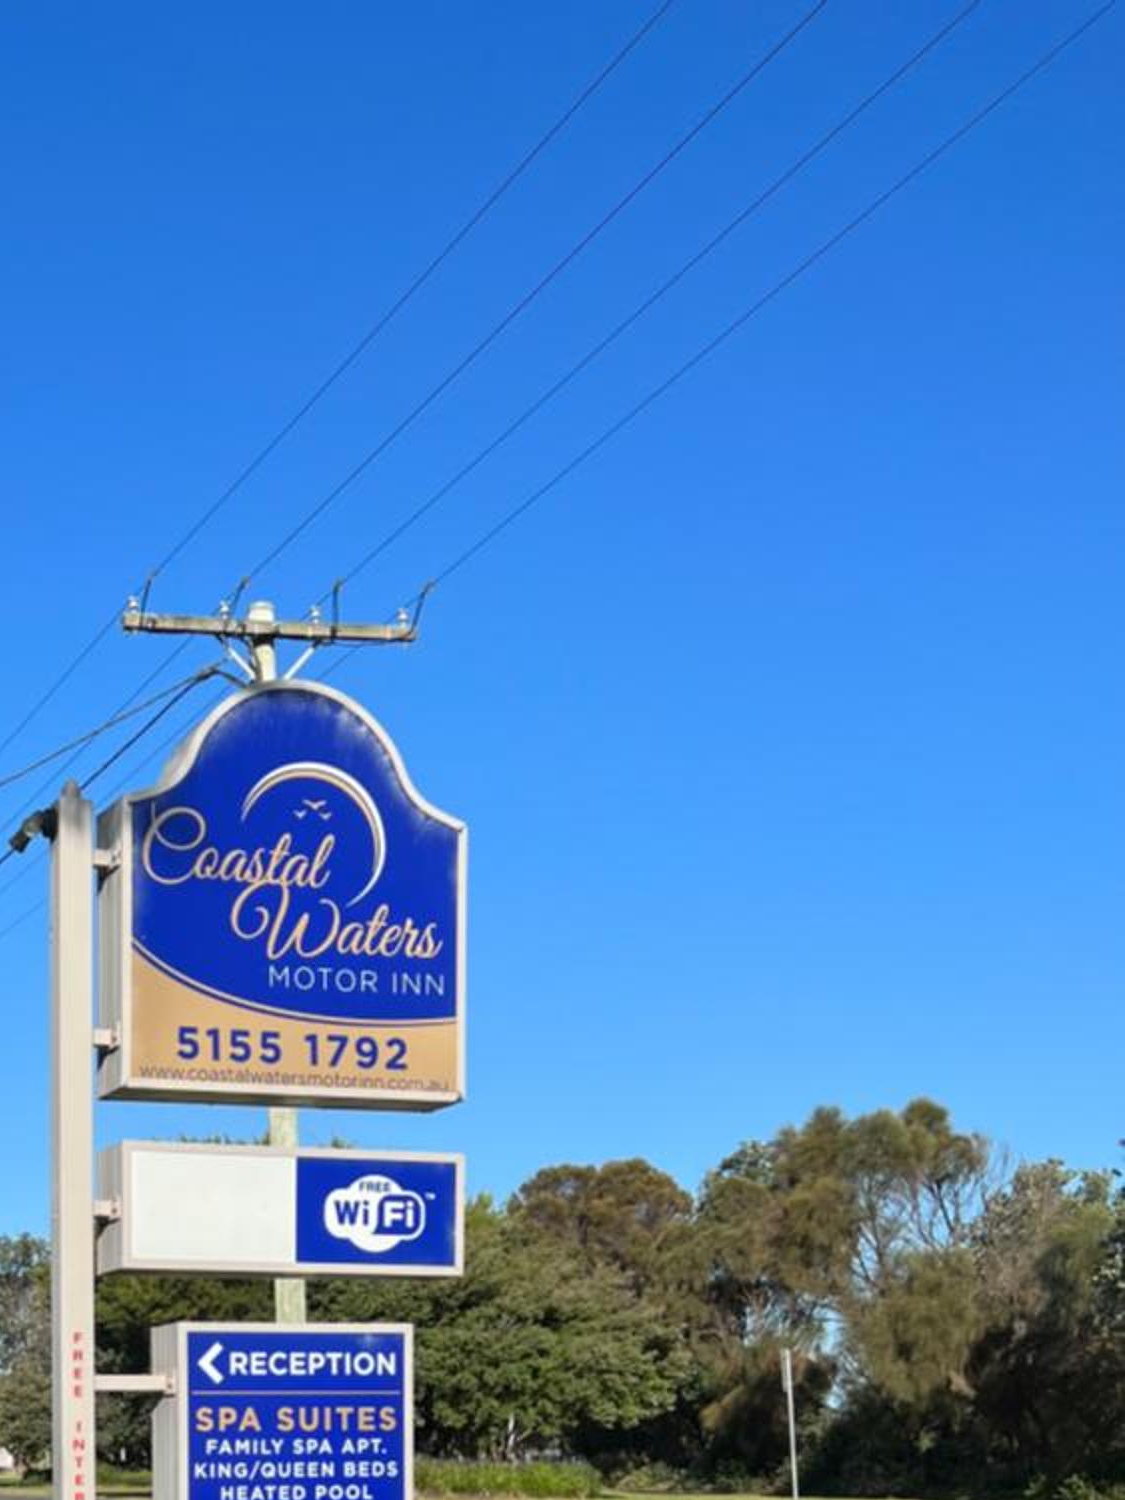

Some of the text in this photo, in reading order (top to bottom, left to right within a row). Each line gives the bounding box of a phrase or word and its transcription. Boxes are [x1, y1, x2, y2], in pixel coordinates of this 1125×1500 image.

[142, 803, 335, 886] Coastal
[230, 881, 443, 960] Waters
[269, 966, 445, 996] MOTOR INN
[177, 1027, 408, 1071] 5155 1792
[139, 1063, 450, 1092] www.coastalwatersmotorinn.com.au
[359, 1181, 392, 1193] FREE
[73, 1331, 84, 1398] FREE
[229, 1352, 397, 1376] RECEPTION
[195, 1407, 397, 1431] SPA SUITES
[205, 1438, 387, 1455] FAMILY SPA APT.
[194, 1461, 398, 1480] KING/QUEEN BEDS
[315, 1485, 373, 1500] POOL
